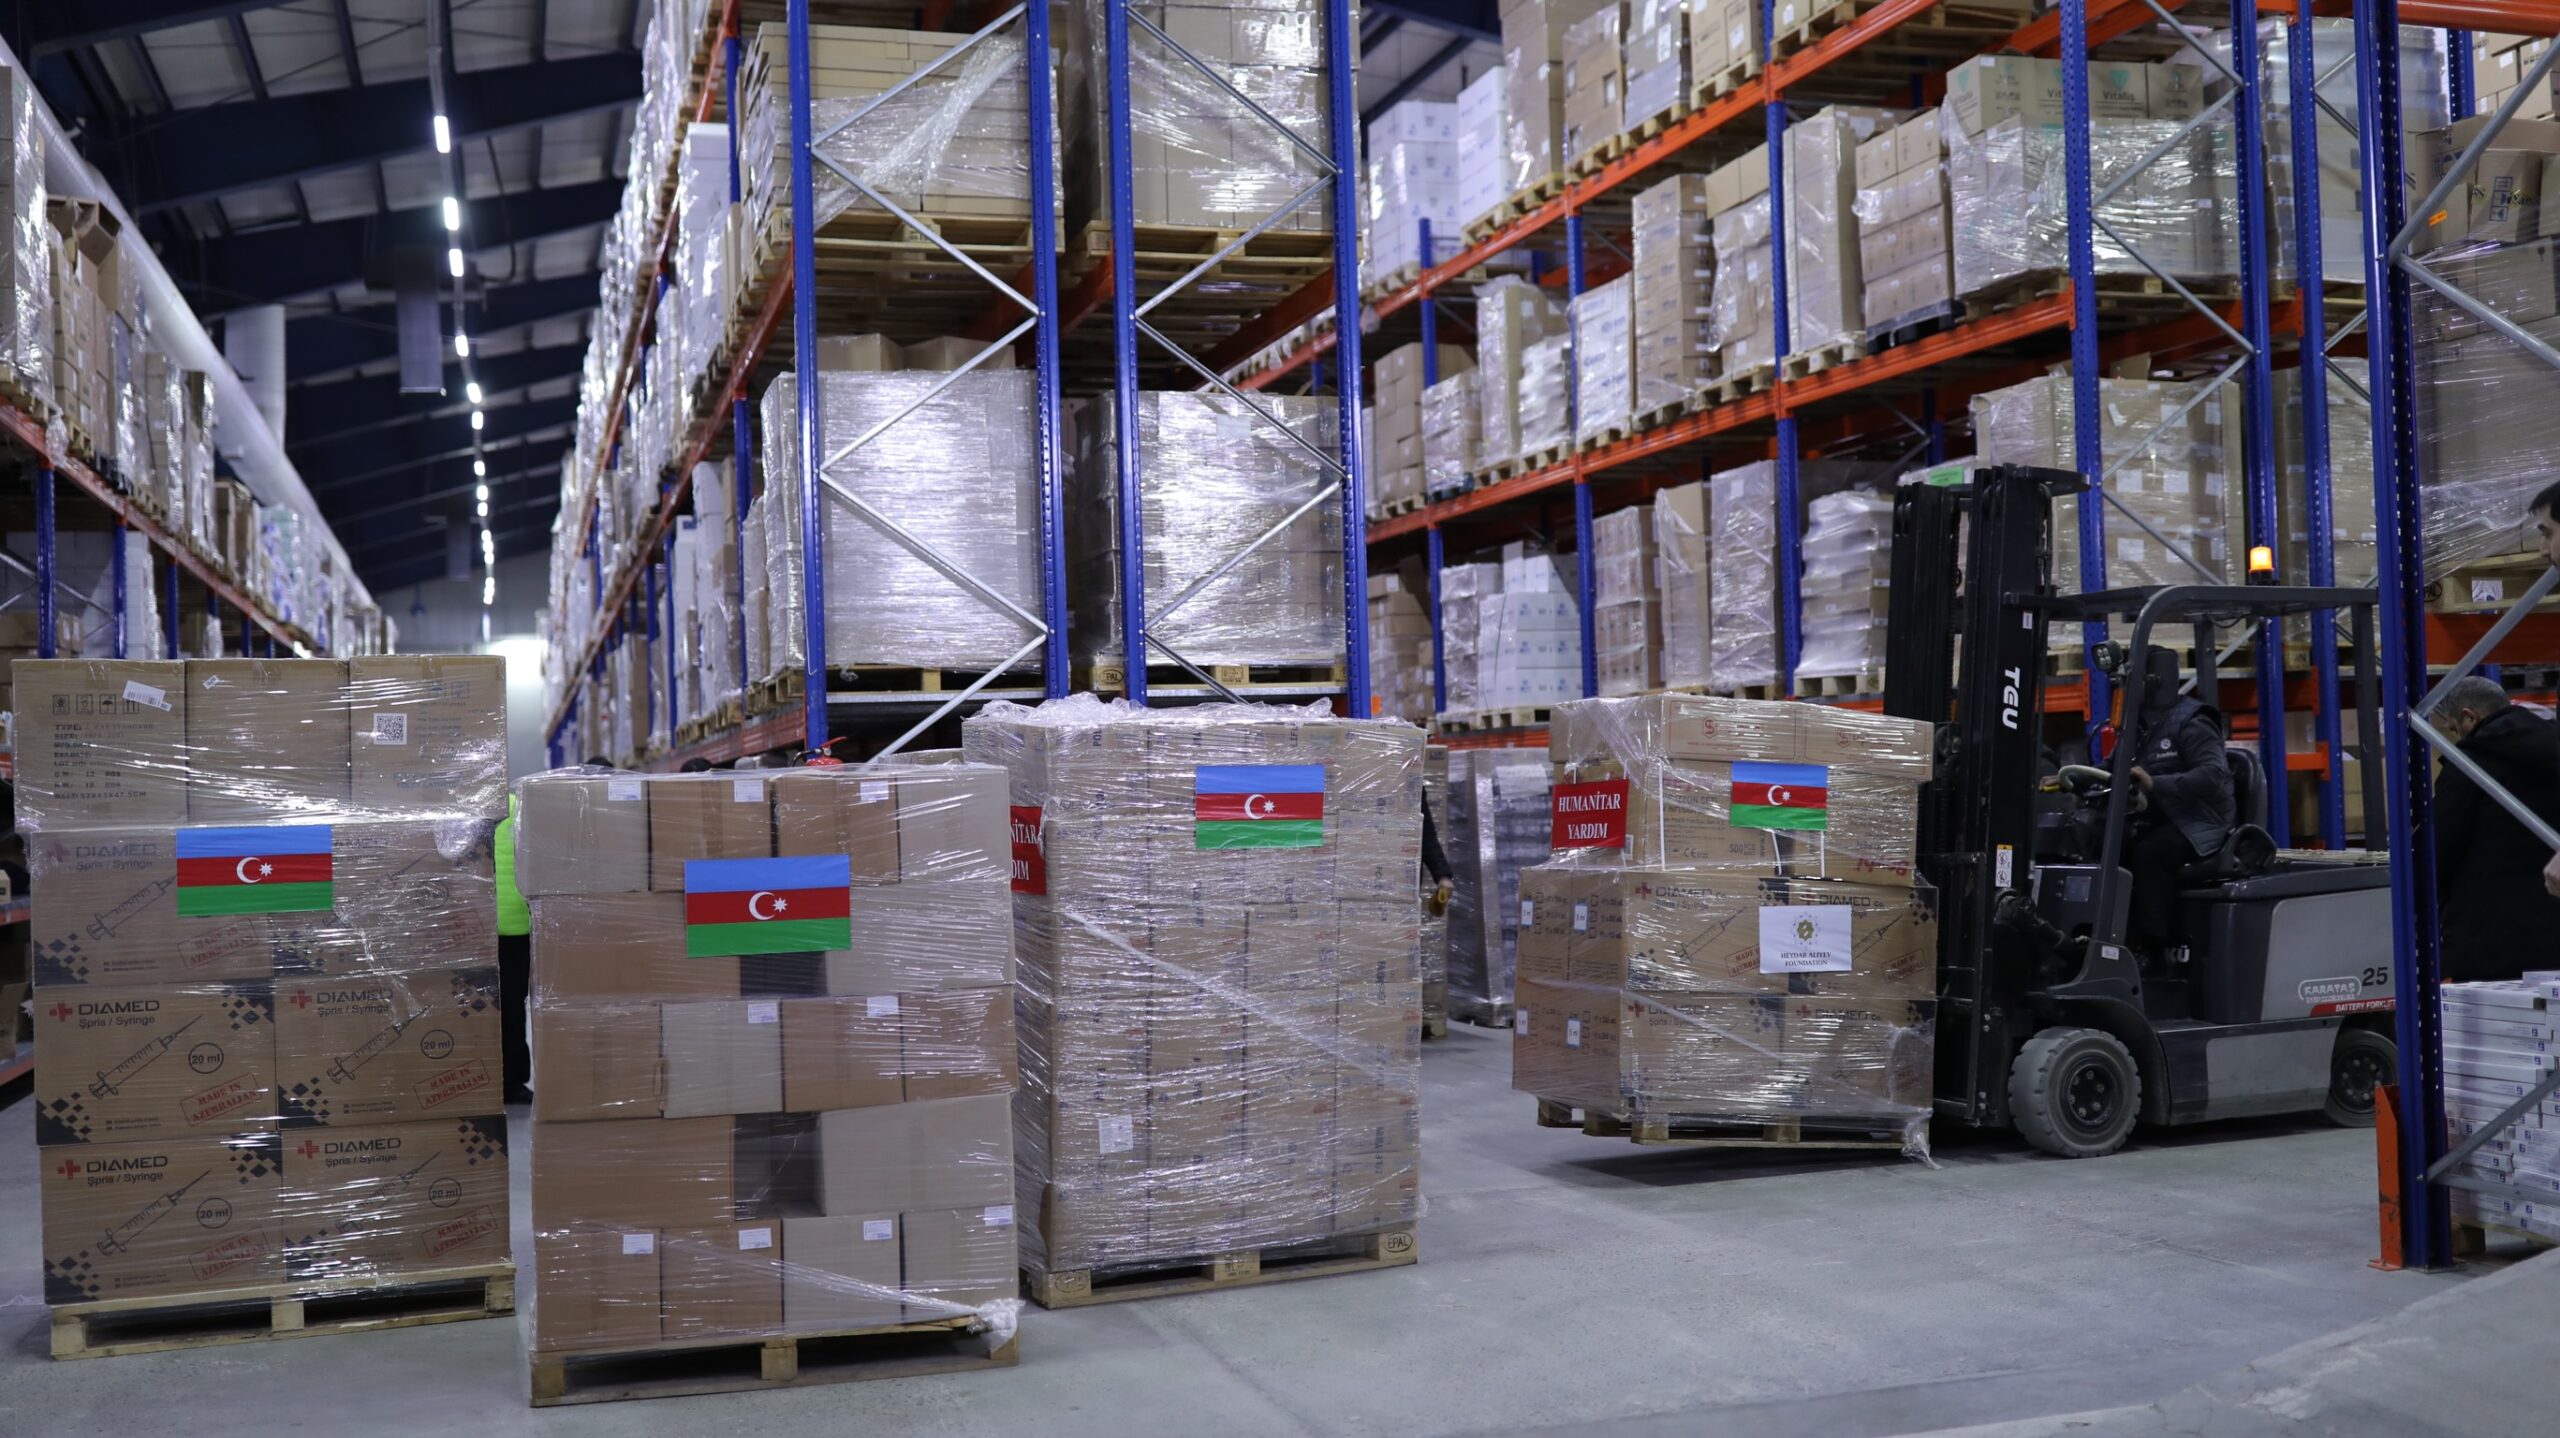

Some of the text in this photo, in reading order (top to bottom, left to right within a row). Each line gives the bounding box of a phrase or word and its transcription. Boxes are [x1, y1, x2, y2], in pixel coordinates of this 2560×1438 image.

[2103, 90, 2135, 101] Vitalis
[2002, 666, 2020, 730] TEU
[1558, 790, 1621, 812] HUMANİTAR
[1567, 822, 1609, 840] YARDIM
[1785, 959, 1828, 967] FOUNDATION
[2362, 966, 2388, 986] 25
[317, 988, 394, 1004] DIAMED
[78, 1000, 160, 1015] DIAMED
[318, 1005, 343, 1017] Şpris
[352, 1003, 389, 1014] Syringe
[2336, 1003, 2365, 1012] BATTERY
[79, 1018, 106, 1030] Şpris
[117, 1015, 155, 1026] Syringe
[424, 1039, 451, 1049] 20 ml
[191, 1053, 221, 1064] 20 ml
[429, 1068, 472, 1090] MADE IN
[198, 1081, 241, 1105] MADE IN
[424, 1075, 485, 1106] AZERBAIJAN
[192, 1090, 258, 1122] AZERBAIJAN
[324, 1137, 401, 1154] DIAMED
[87, 1156, 168, 1172] DIAMED
[325, 1156, 351, 1168] Şpris
[87, 1175, 114, 1187] Şpris
[124, 1172, 163, 1183] Syringe
[431, 1188, 458, 1199] 20 ml
[200, 1208, 229, 1219] 20 ml
[1387, 1236, 1409, 1249] EPAL
